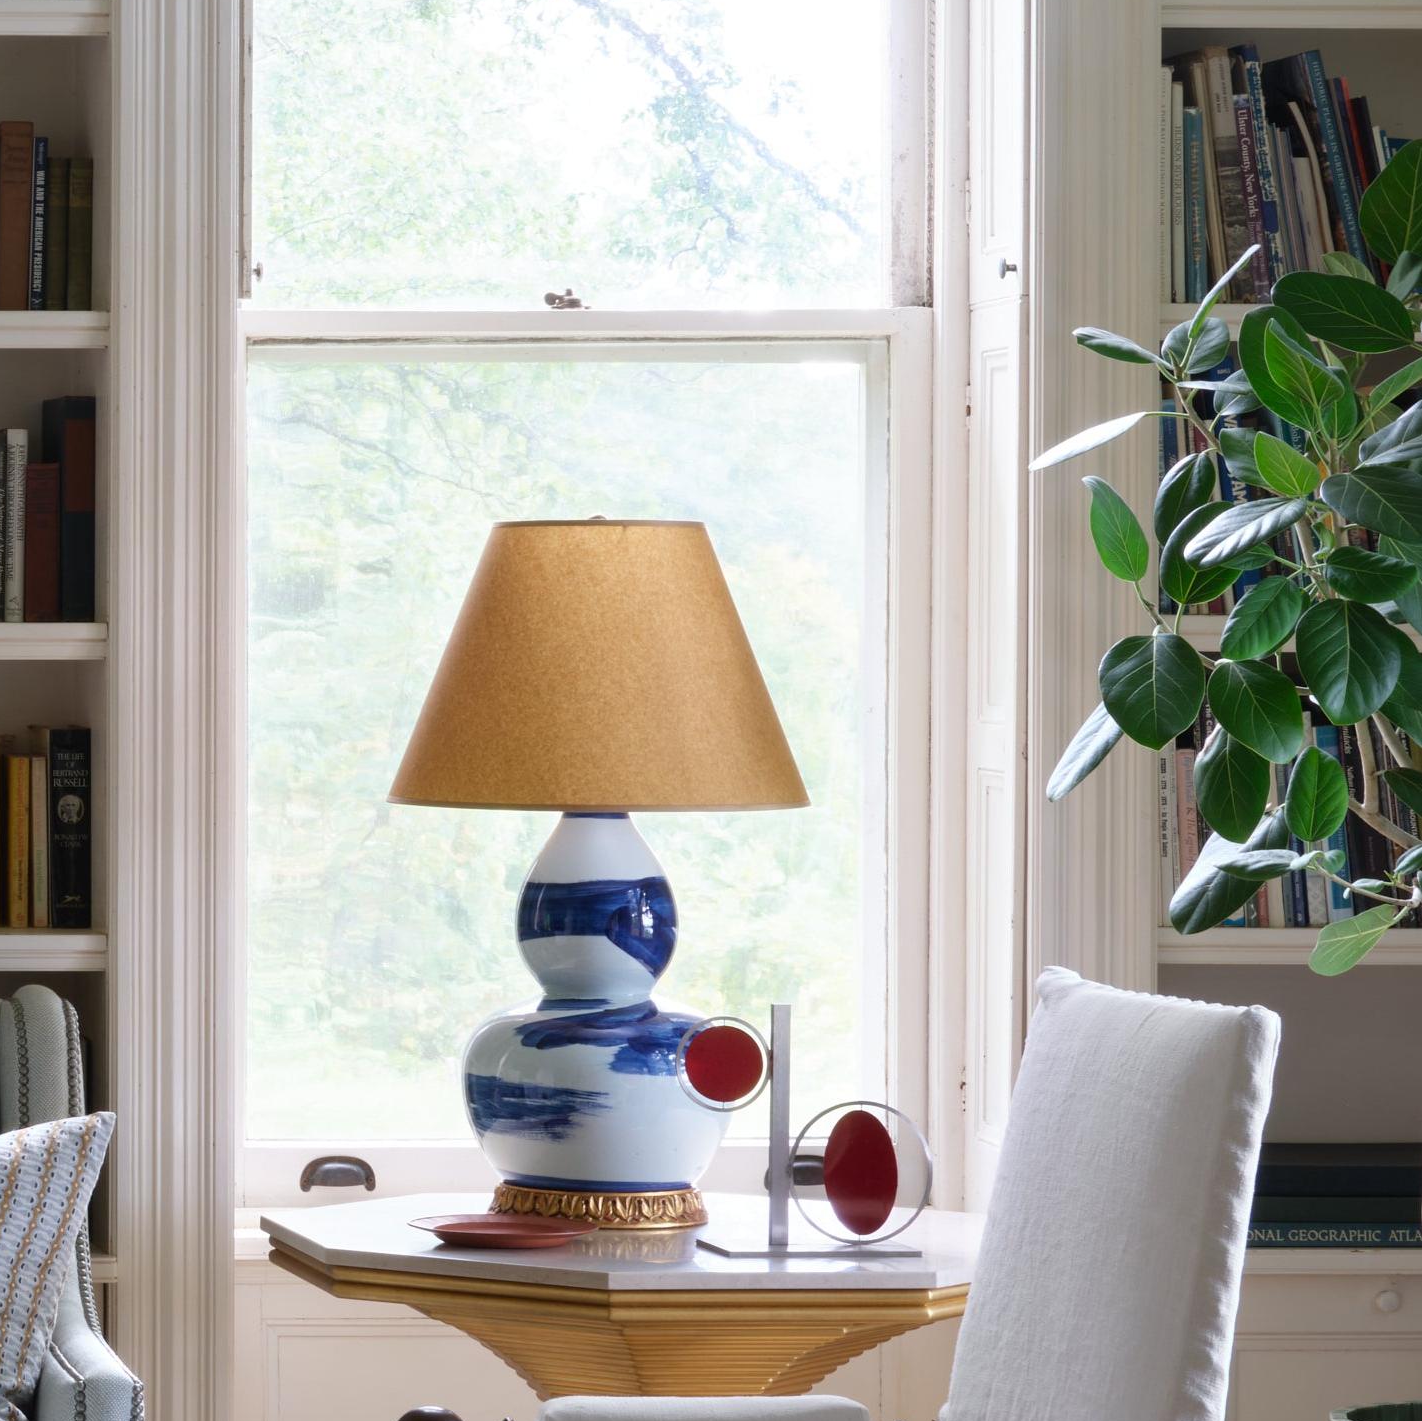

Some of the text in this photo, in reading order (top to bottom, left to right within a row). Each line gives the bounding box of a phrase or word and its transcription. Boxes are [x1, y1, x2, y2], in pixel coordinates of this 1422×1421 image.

[1311, 60, 1356, 233] HISTORIC PLACES IN GREENE COUNTY
[32, 170, 46, 293] WAR AND THE AMERICAN PRESIDENCY
[52, 769, 89, 777] BERTRAND
[53, 778, 89, 787] RUSSELL
[1287, 1229, 1382, 1242] GEOGRAPHIC
